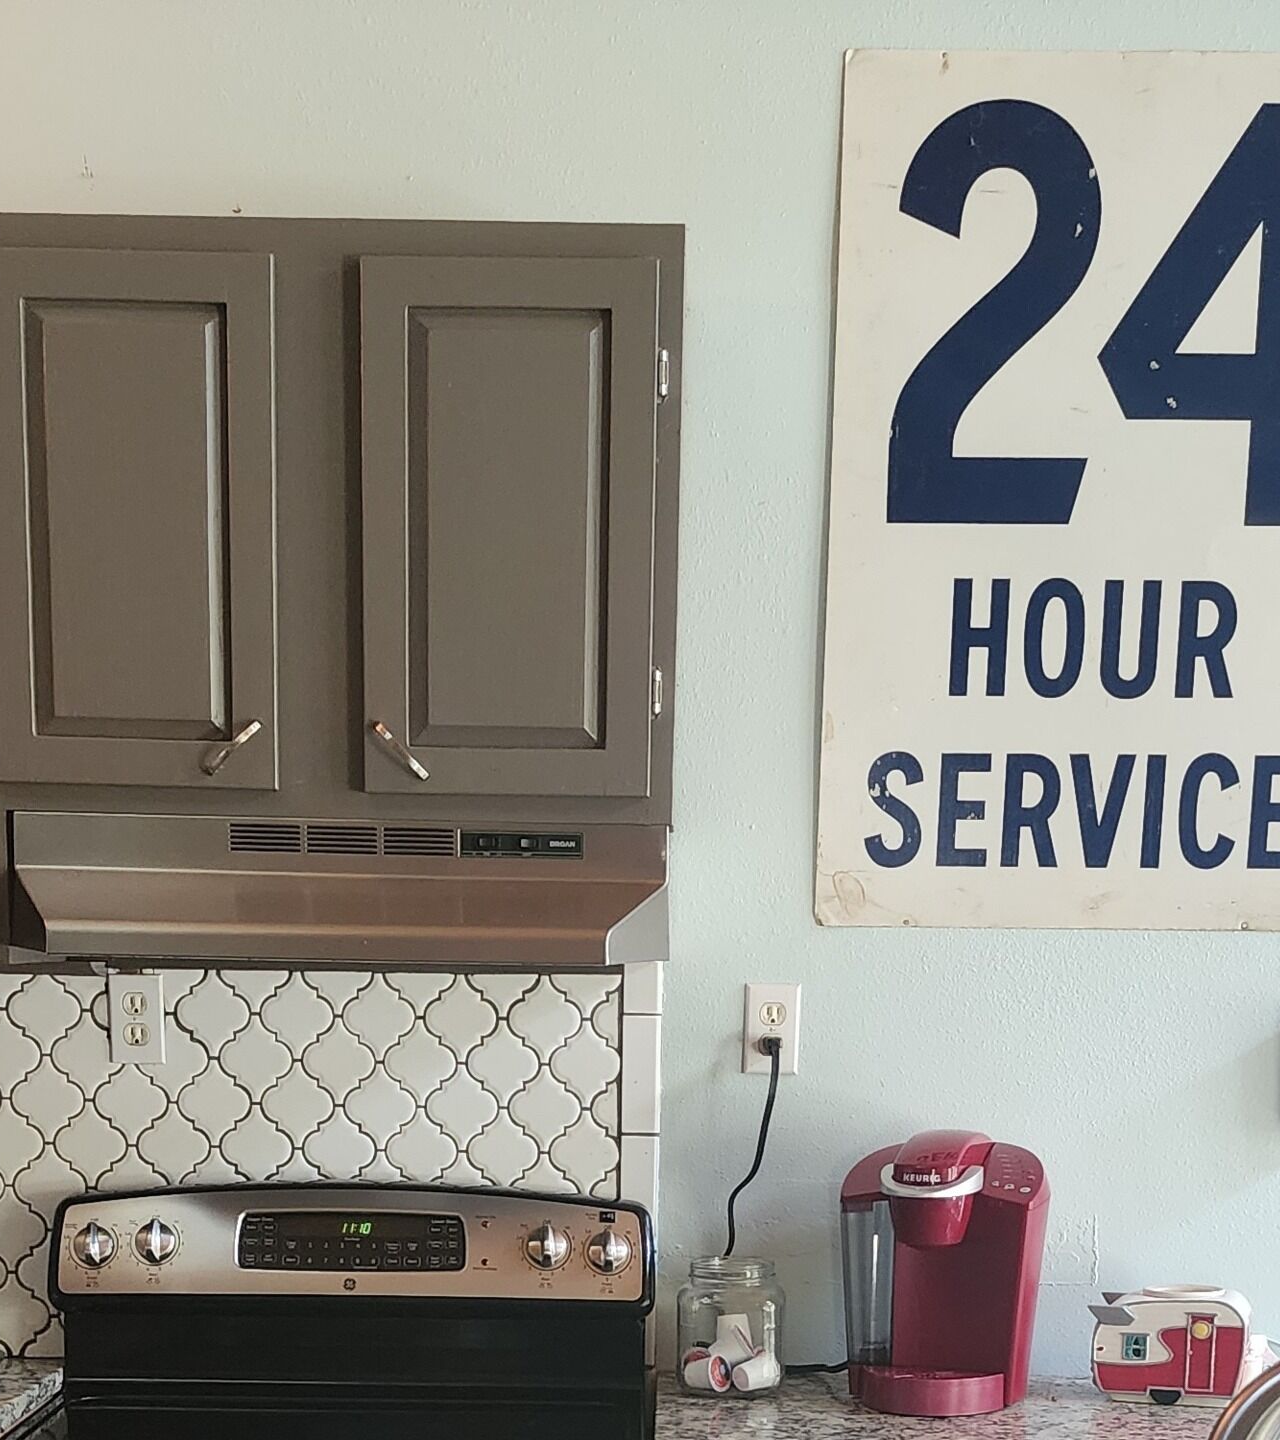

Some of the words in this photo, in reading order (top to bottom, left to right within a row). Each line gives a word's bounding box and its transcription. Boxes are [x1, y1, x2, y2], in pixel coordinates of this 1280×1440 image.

[948, 578, 1239, 700] HOUR
[902, 1172, 942, 1184] KEURIG
[342, 1222, 372, 1235] 11:10
